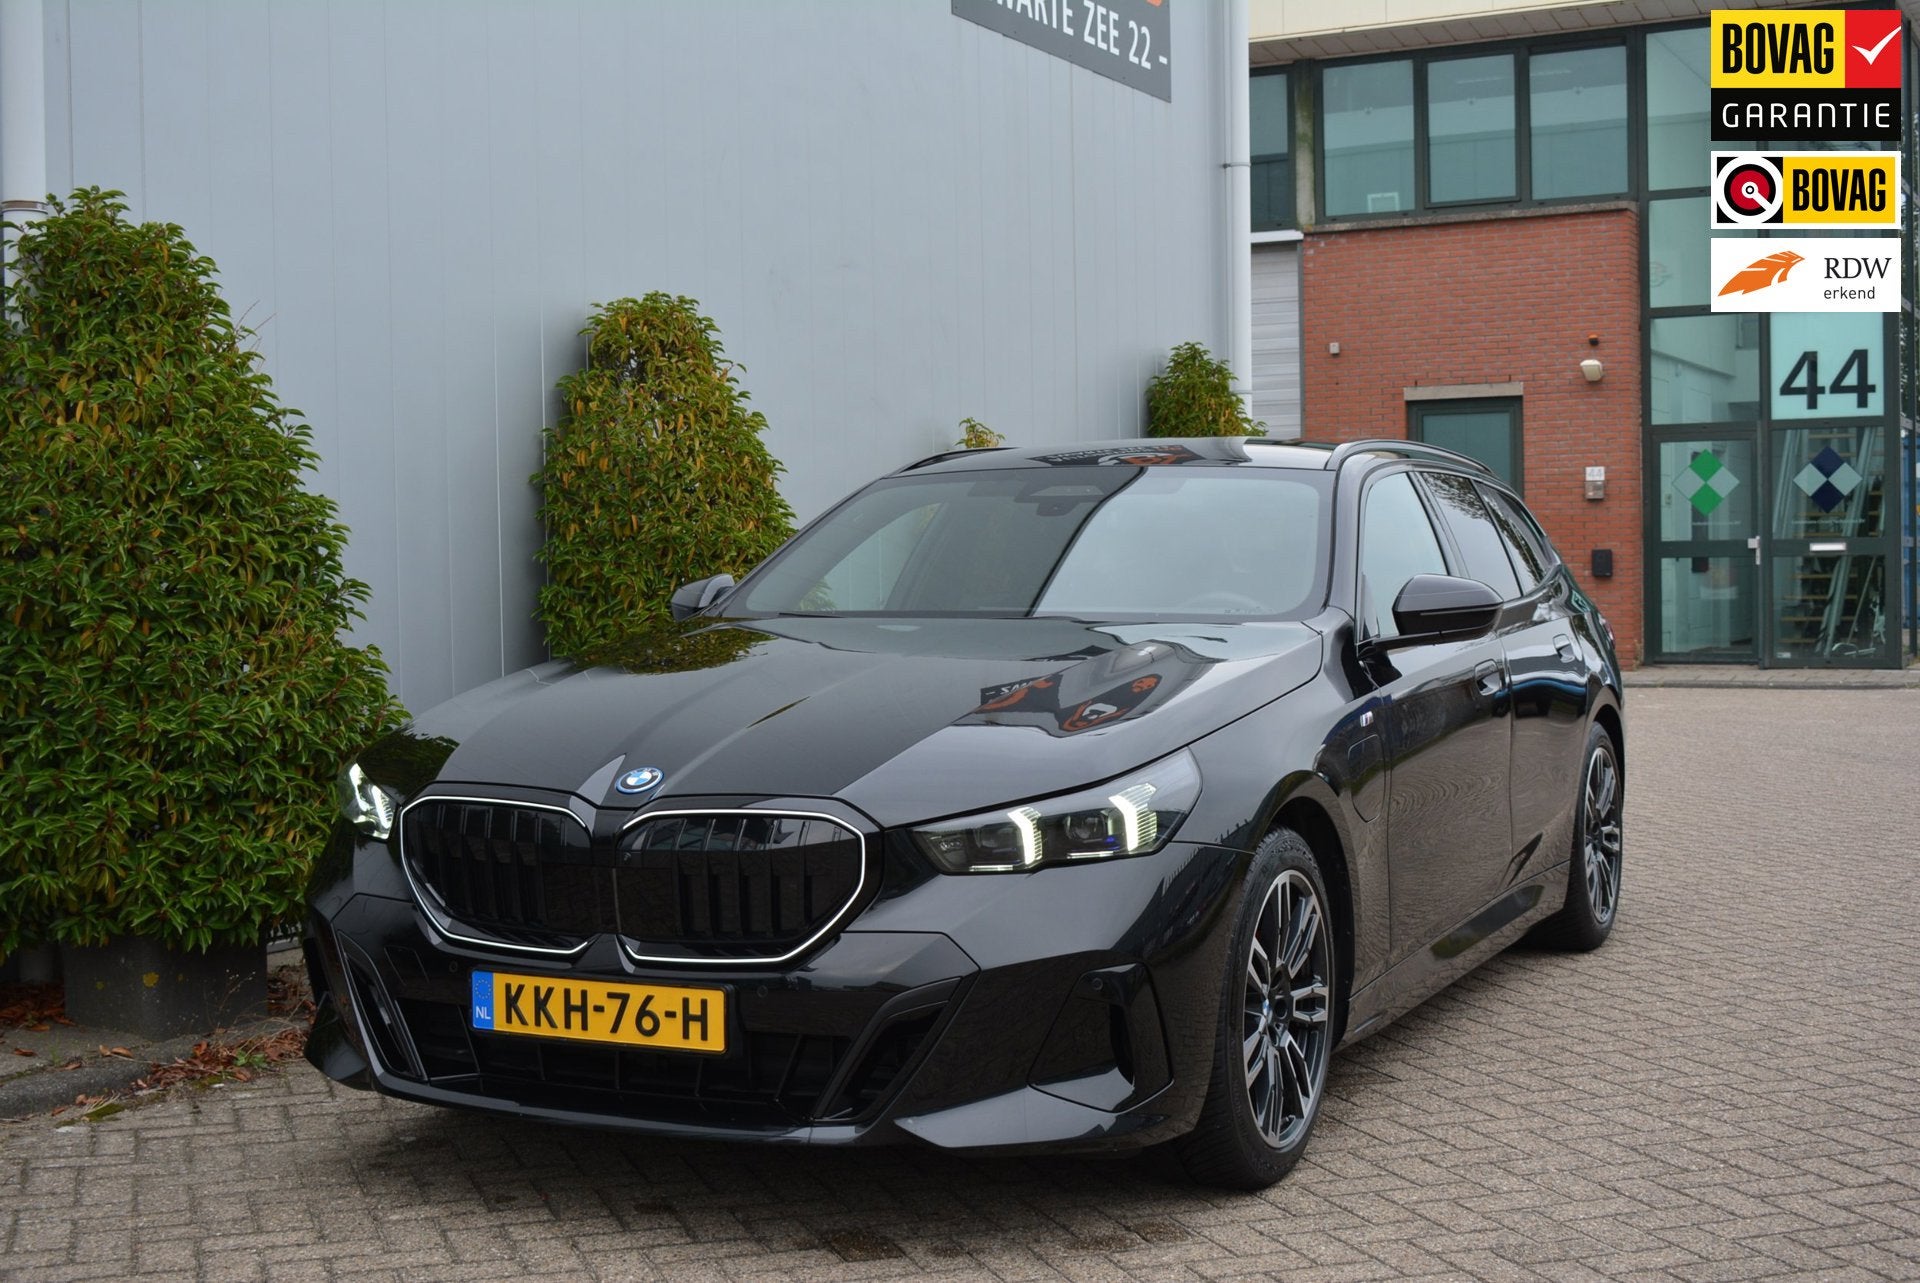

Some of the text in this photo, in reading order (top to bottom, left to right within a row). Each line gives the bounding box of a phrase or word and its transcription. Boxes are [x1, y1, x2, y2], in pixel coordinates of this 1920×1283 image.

[1083, 1, 1120, 56] ZEE
[1128, 20, 1151, 70] 22
[1779, 349, 1876, 410] 44
[475, 1005, 492, 1020] NL
[504, 982, 709, 1041] KKH-76-H
